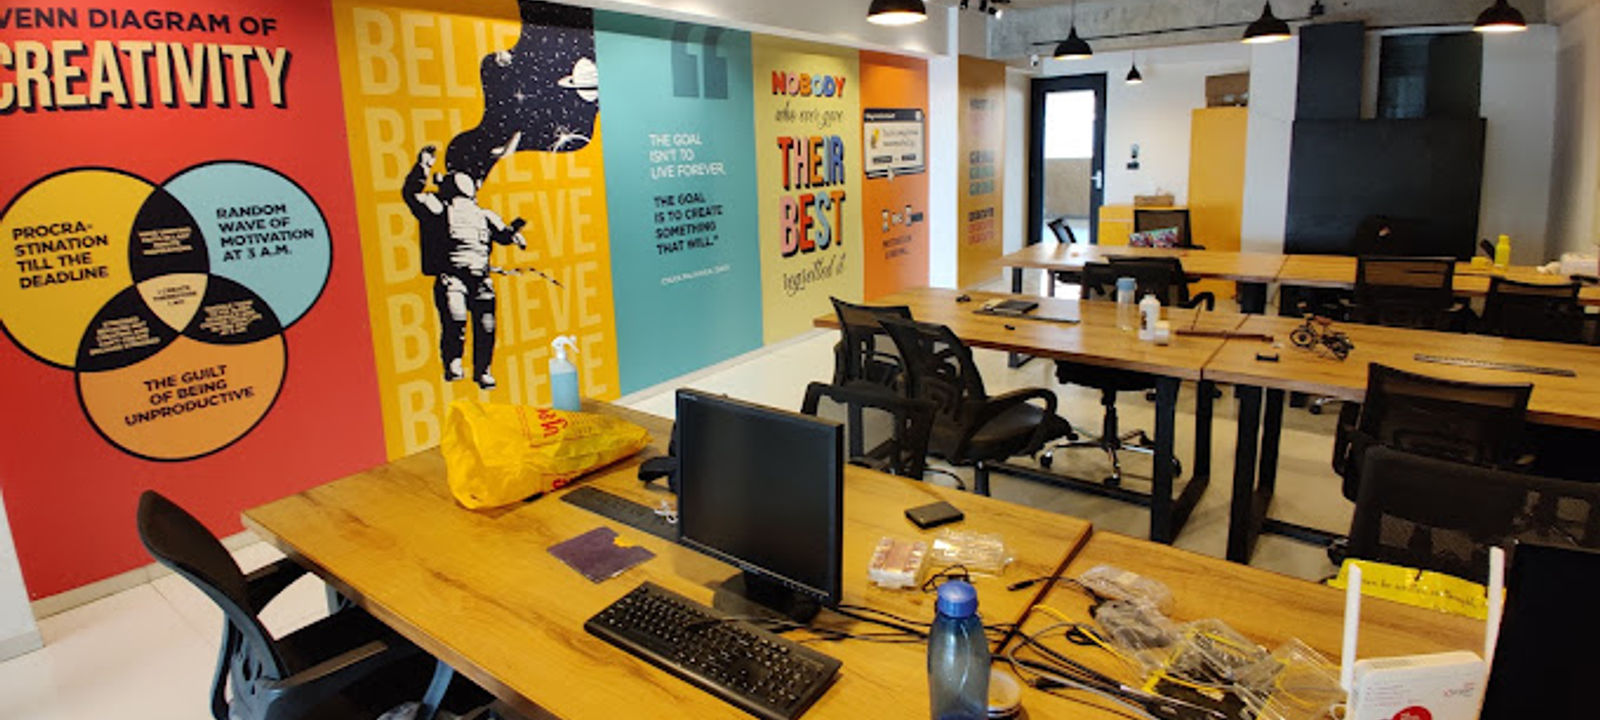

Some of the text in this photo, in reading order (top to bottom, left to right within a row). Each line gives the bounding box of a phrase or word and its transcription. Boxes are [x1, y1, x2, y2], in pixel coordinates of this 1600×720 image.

[88, 9, 231, 34] DIAGRAM
[240, 16, 277, 36] OF
[772, 70, 846, 98] NOBODY
[648, 132, 703, 147] THE GOAL
[679, 148, 695, 161] TO
[776, 135, 845, 191] THEIR
[650, 164, 675, 180] LIVE
[654, 191, 706, 208] THE GOAL
[216, 204, 287, 220] RANDOM
[654, 204, 723, 224] IS TO CREATE
[12, 220, 93, 241] PROCRA-
[218, 216, 291, 234] WAVE OF
[655, 220, 717, 239] SOMETHING
[779, 190, 846, 257] BEST
[14, 234, 109, 257] STINATION
[220, 228, 315, 248] MOTIVATION
[656, 239, 684, 255] THAT
[16, 251, 92, 273] TILL THE
[223, 249, 243, 262] AT
[247, 247, 256, 259] 3
[19, 265, 109, 289] DEADLINE
[143, 364, 227, 392] THE GUILT
[149, 378, 227, 406] OF BEING
[124, 386, 255, 427] UNPRODUCTIVE
